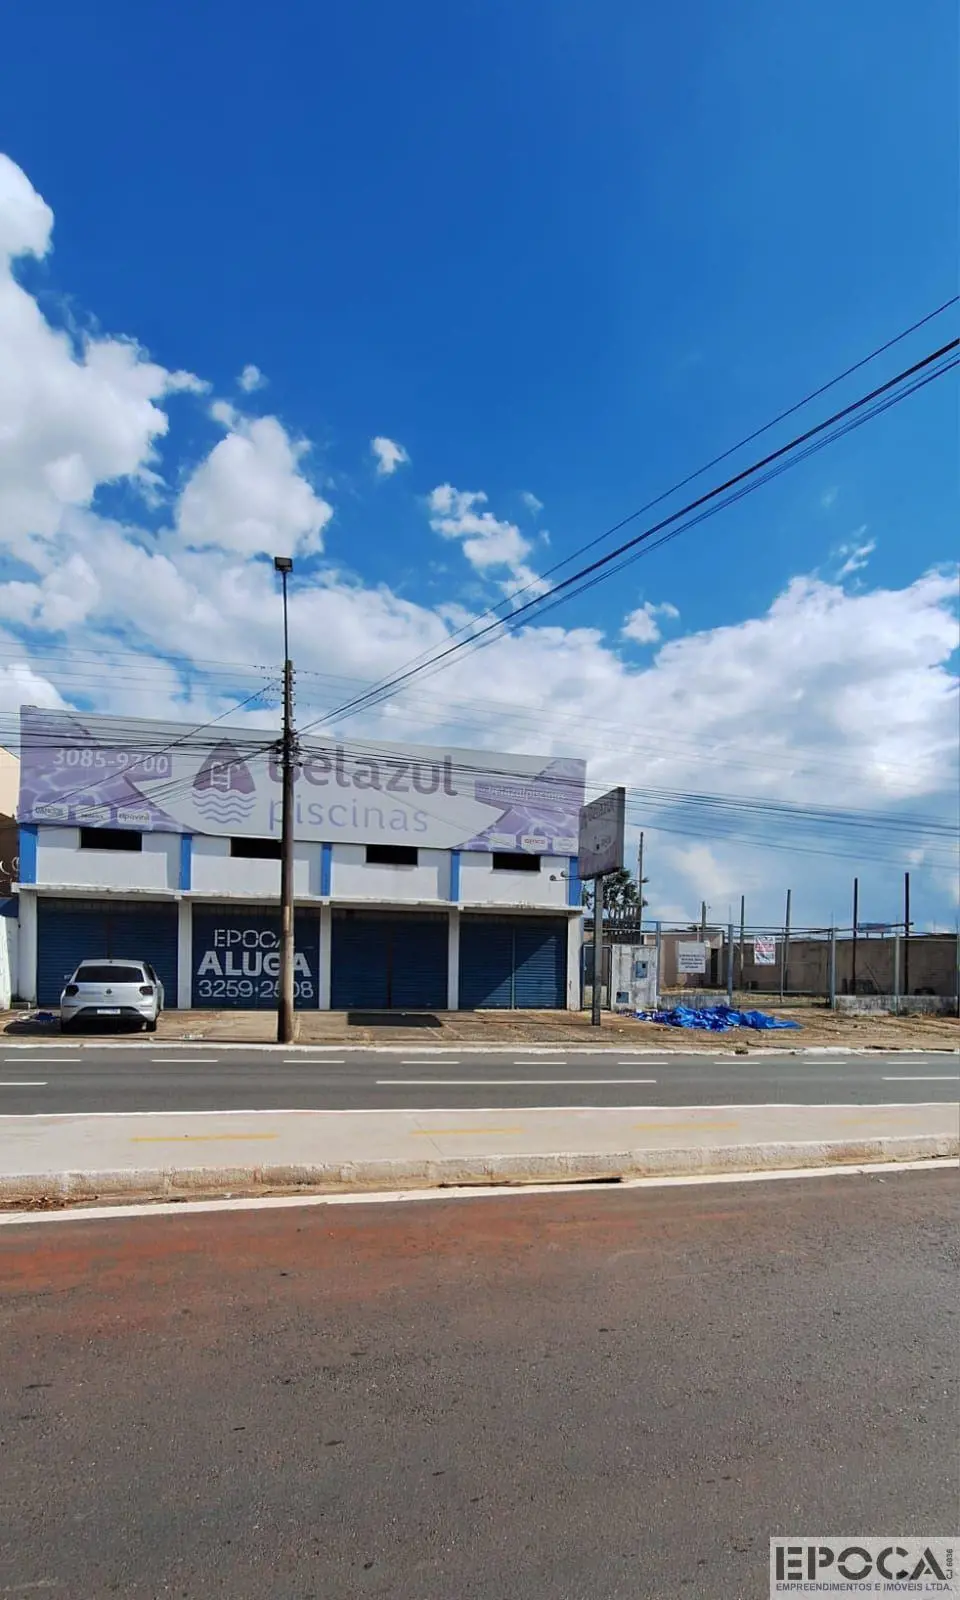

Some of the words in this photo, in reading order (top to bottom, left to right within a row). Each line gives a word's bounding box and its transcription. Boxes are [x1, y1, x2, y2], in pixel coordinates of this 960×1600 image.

[53, 747, 169, 774] 3085-9700
[269, 795, 429, 833] piscinas
[197, 950, 313, 977] ALUGA
